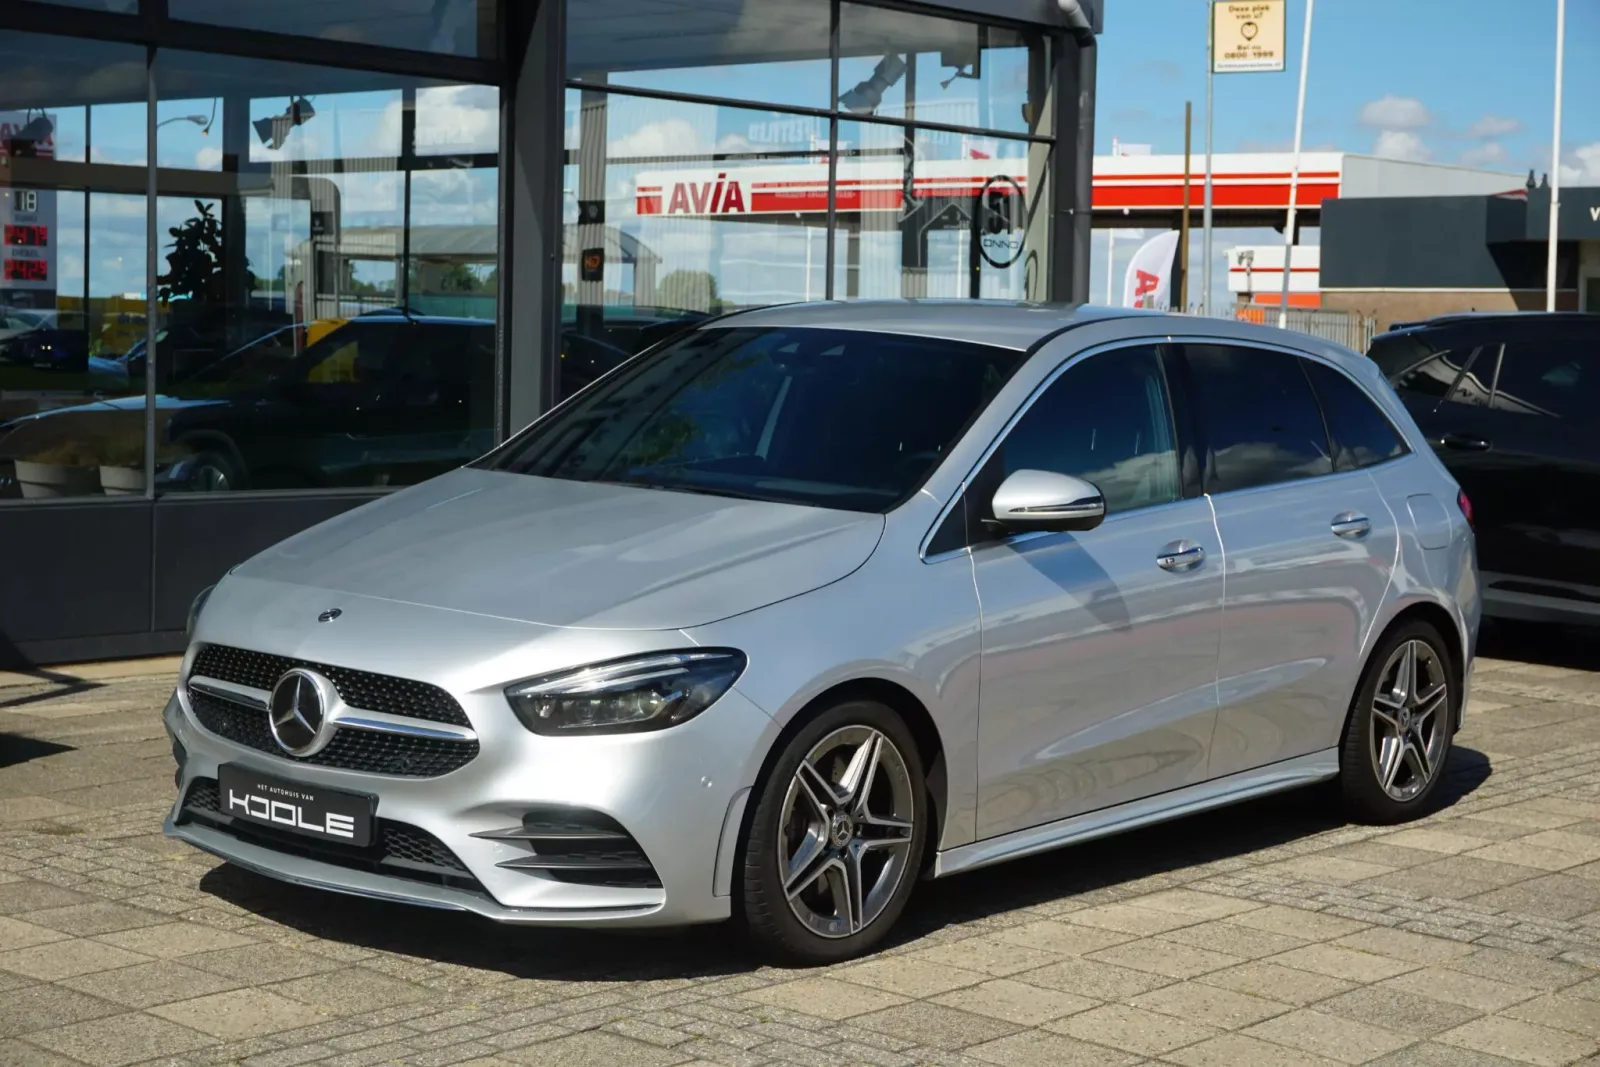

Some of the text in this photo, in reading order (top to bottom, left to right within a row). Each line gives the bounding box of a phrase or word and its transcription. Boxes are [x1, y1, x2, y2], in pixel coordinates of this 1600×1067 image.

[256, 783, 315, 802] HET AUTOHUIS VAN
